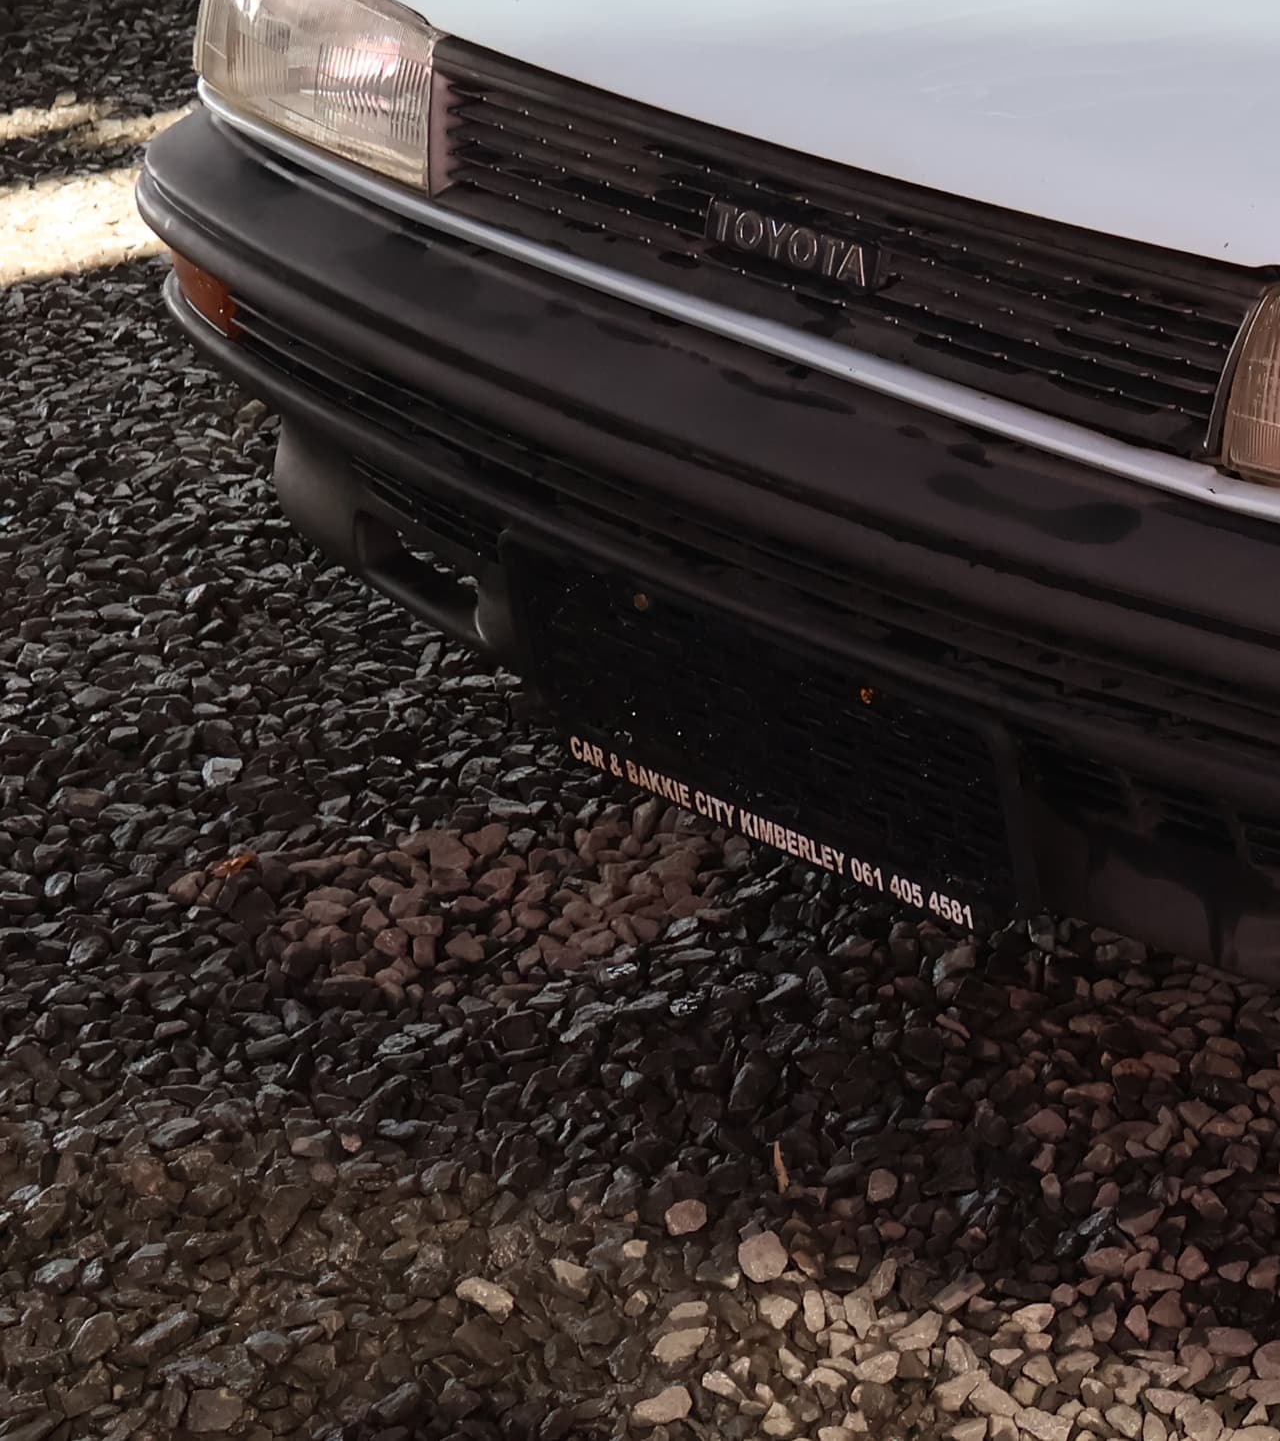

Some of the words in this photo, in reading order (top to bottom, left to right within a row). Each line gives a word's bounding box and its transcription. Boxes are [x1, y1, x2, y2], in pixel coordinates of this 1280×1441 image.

[711, 203, 867, 288] TOYOTA
[569, 735, 605, 770] CAR
[609, 752, 624, 778] &
[625, 759, 692, 808] BAKKIE
[695, 790, 736, 830] CITY
[738, 808, 846, 877] KIMBERLEY
[849, 856, 885, 893] 061
[888, 873, 925, 909] 405
[928, 888, 975, 931] 4581
